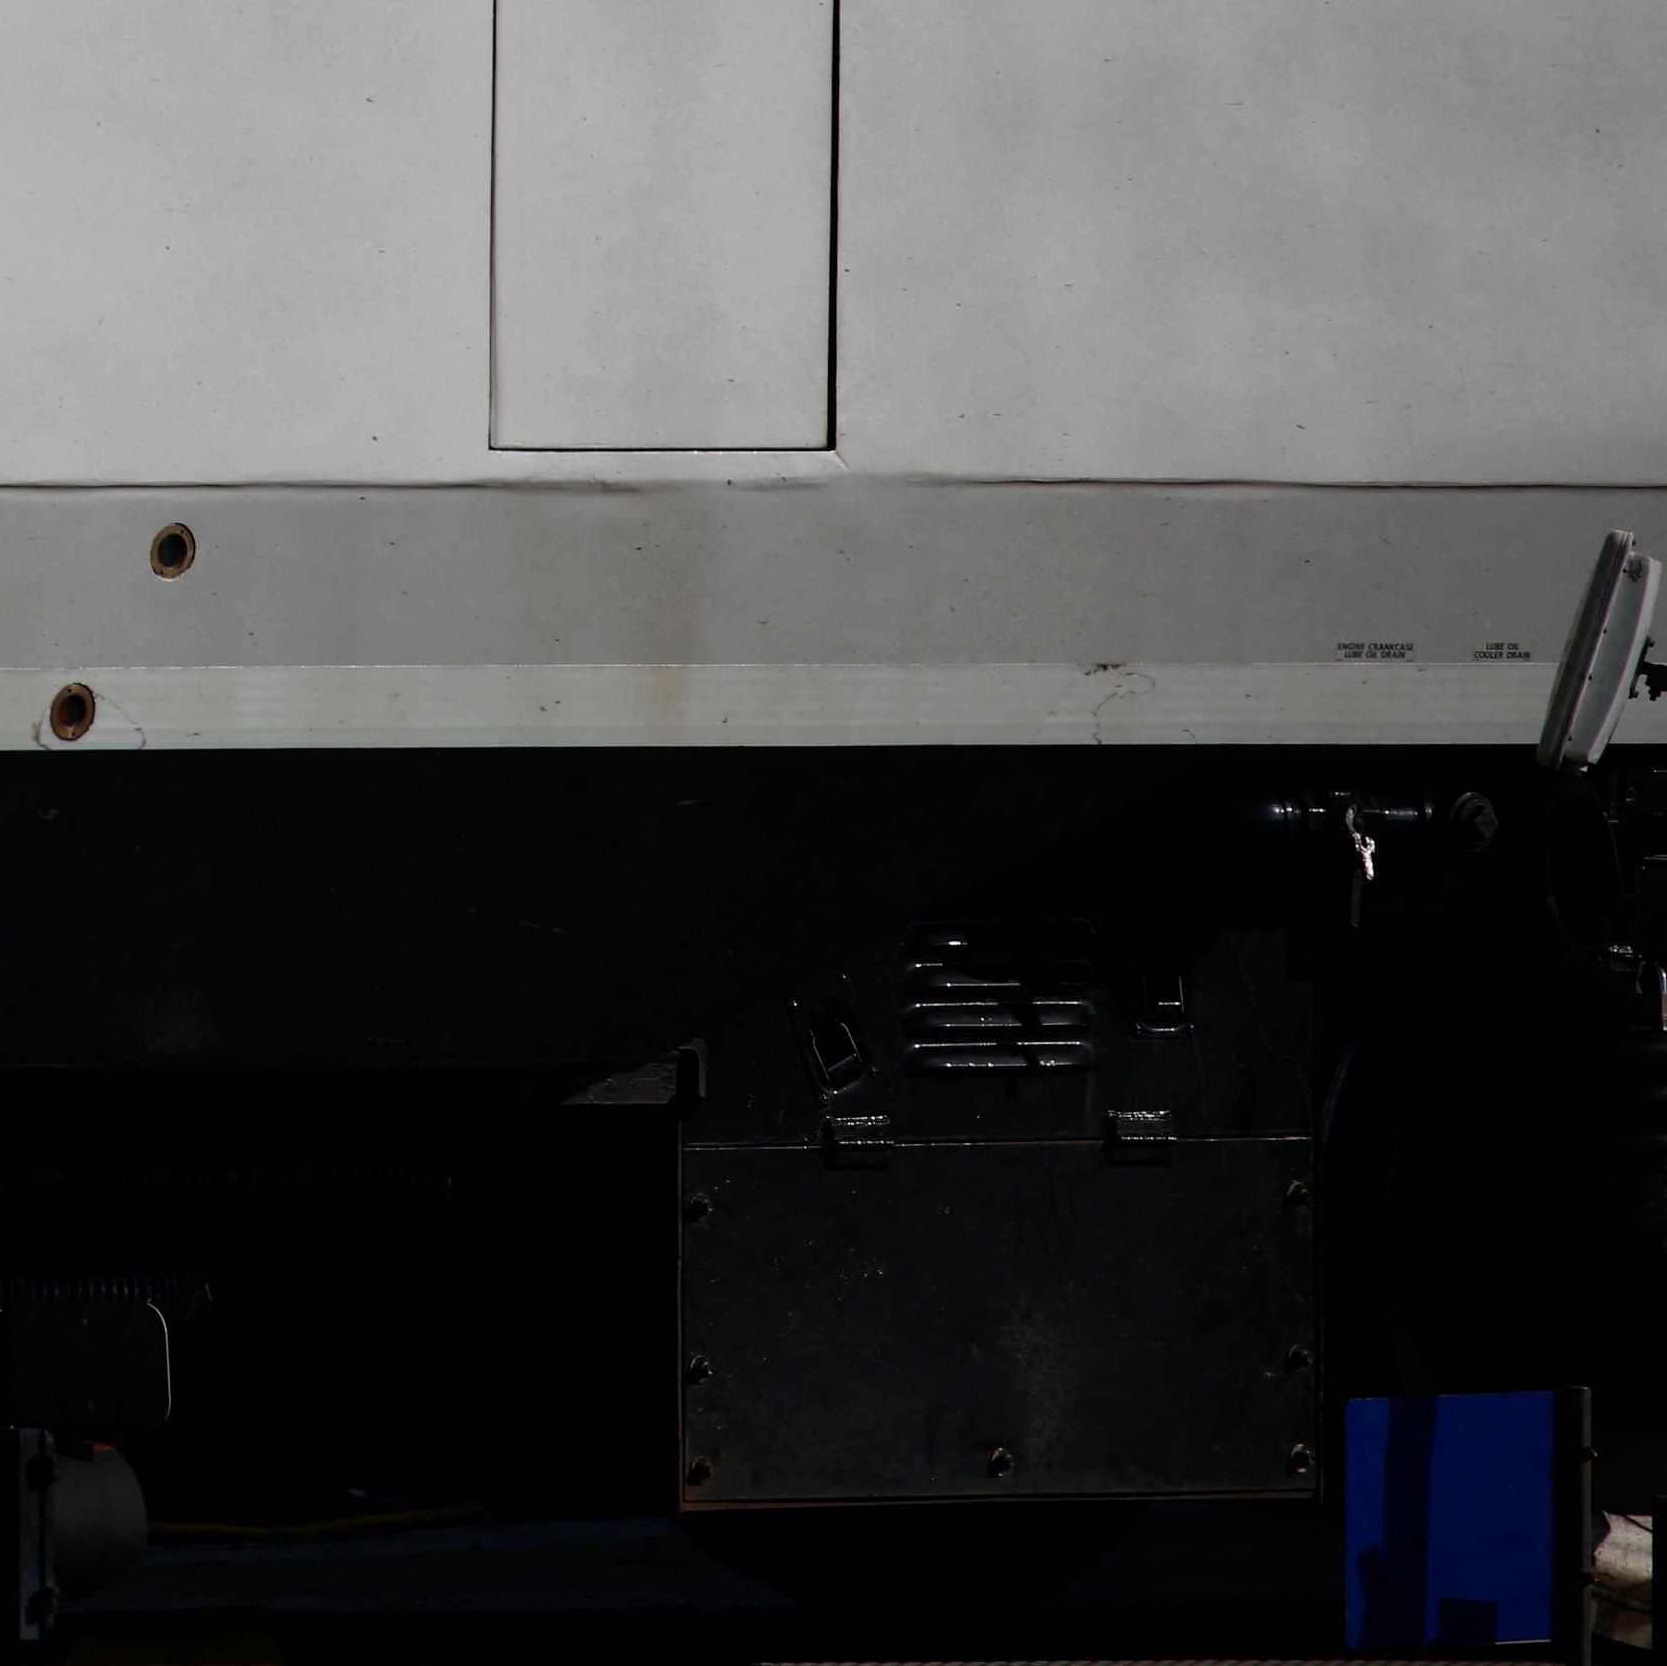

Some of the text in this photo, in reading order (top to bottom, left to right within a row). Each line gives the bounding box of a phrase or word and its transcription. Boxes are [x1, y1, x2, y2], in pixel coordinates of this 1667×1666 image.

[1338, 642, 1414, 651] ENGINE CRANKCASE
[1486, 642, 1519, 650] LUBE OIL
[1381, 651, 1406, 659] DRAIN
[1474, 651, 1531, 659] COOLER DRAIN
